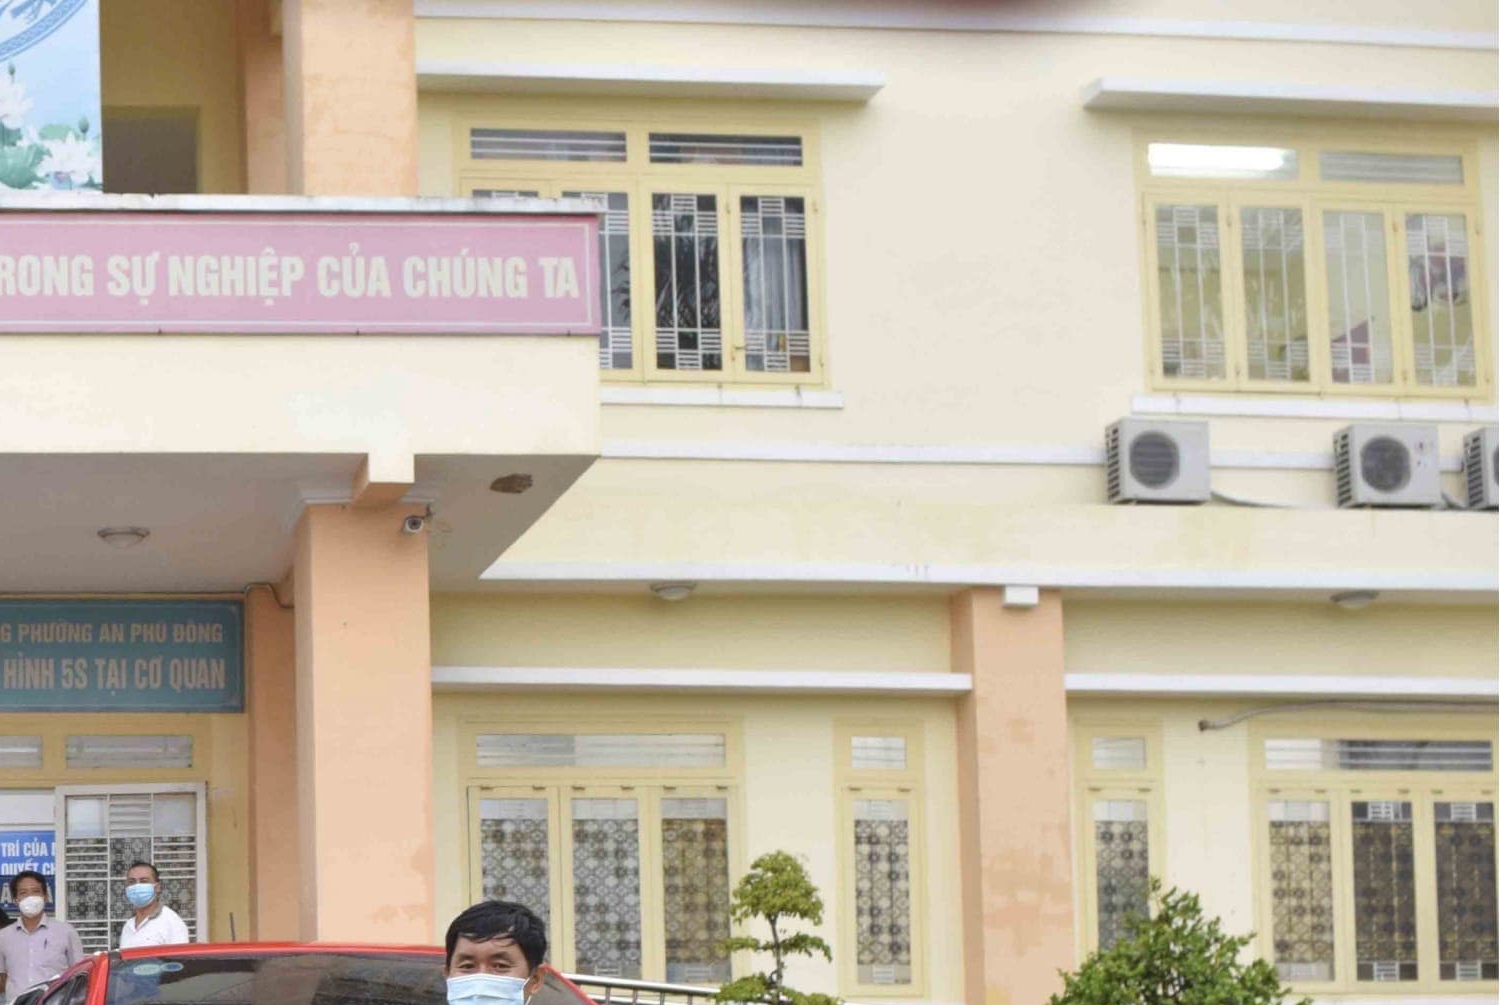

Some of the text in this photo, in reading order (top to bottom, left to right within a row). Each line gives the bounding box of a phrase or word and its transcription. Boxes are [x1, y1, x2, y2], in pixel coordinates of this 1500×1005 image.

[106, 251, 159, 306] SỰ
[168, 247, 304, 306] NGHIỆP
[317, 242, 392, 297] CỦA
[403, 248, 526, 297] CHÚNG
[539, 256, 580, 298] TA
[99, 623, 124, 643] AN
[3, 651, 55, 689] HÌNH
[61, 657, 88, 690] 5S
[95, 657, 127, 696] TẠI
[134, 654, 164, 690] CƠ
[169, 657, 226, 692] QUAN
[0, 840, 20, 857] TRÍ
[23, 837, 48, 857] CỦA
